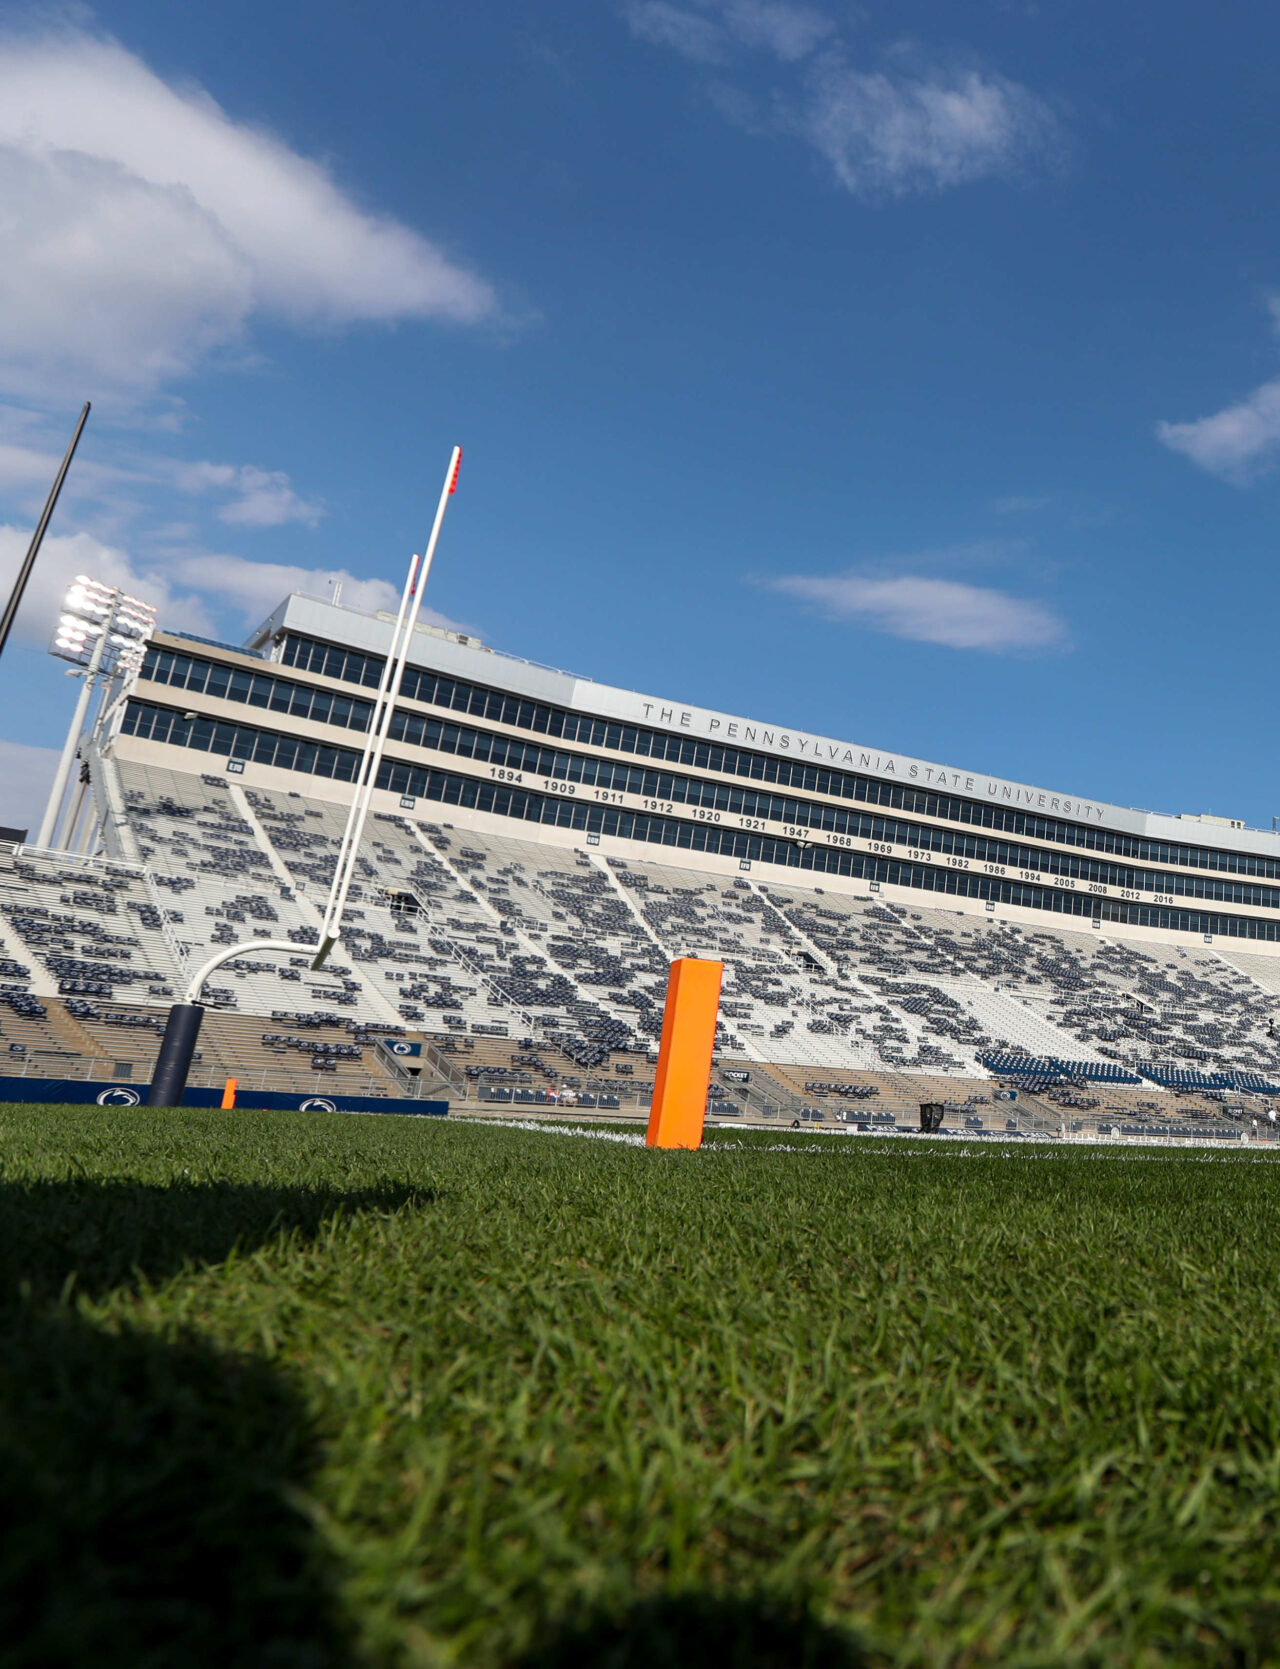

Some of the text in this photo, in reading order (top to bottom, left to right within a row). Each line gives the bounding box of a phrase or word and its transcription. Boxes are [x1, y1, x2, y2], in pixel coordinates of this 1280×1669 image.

[642, 702, 1105, 821] THE PENNSYLVANIA STATE UNIVERSITY
[489, 767, 1174, 905] 1894 1909 1911 1912 1920 1921 1947 1968 1969 1973 1982 1986 1994 2005 2008 2012 2016
